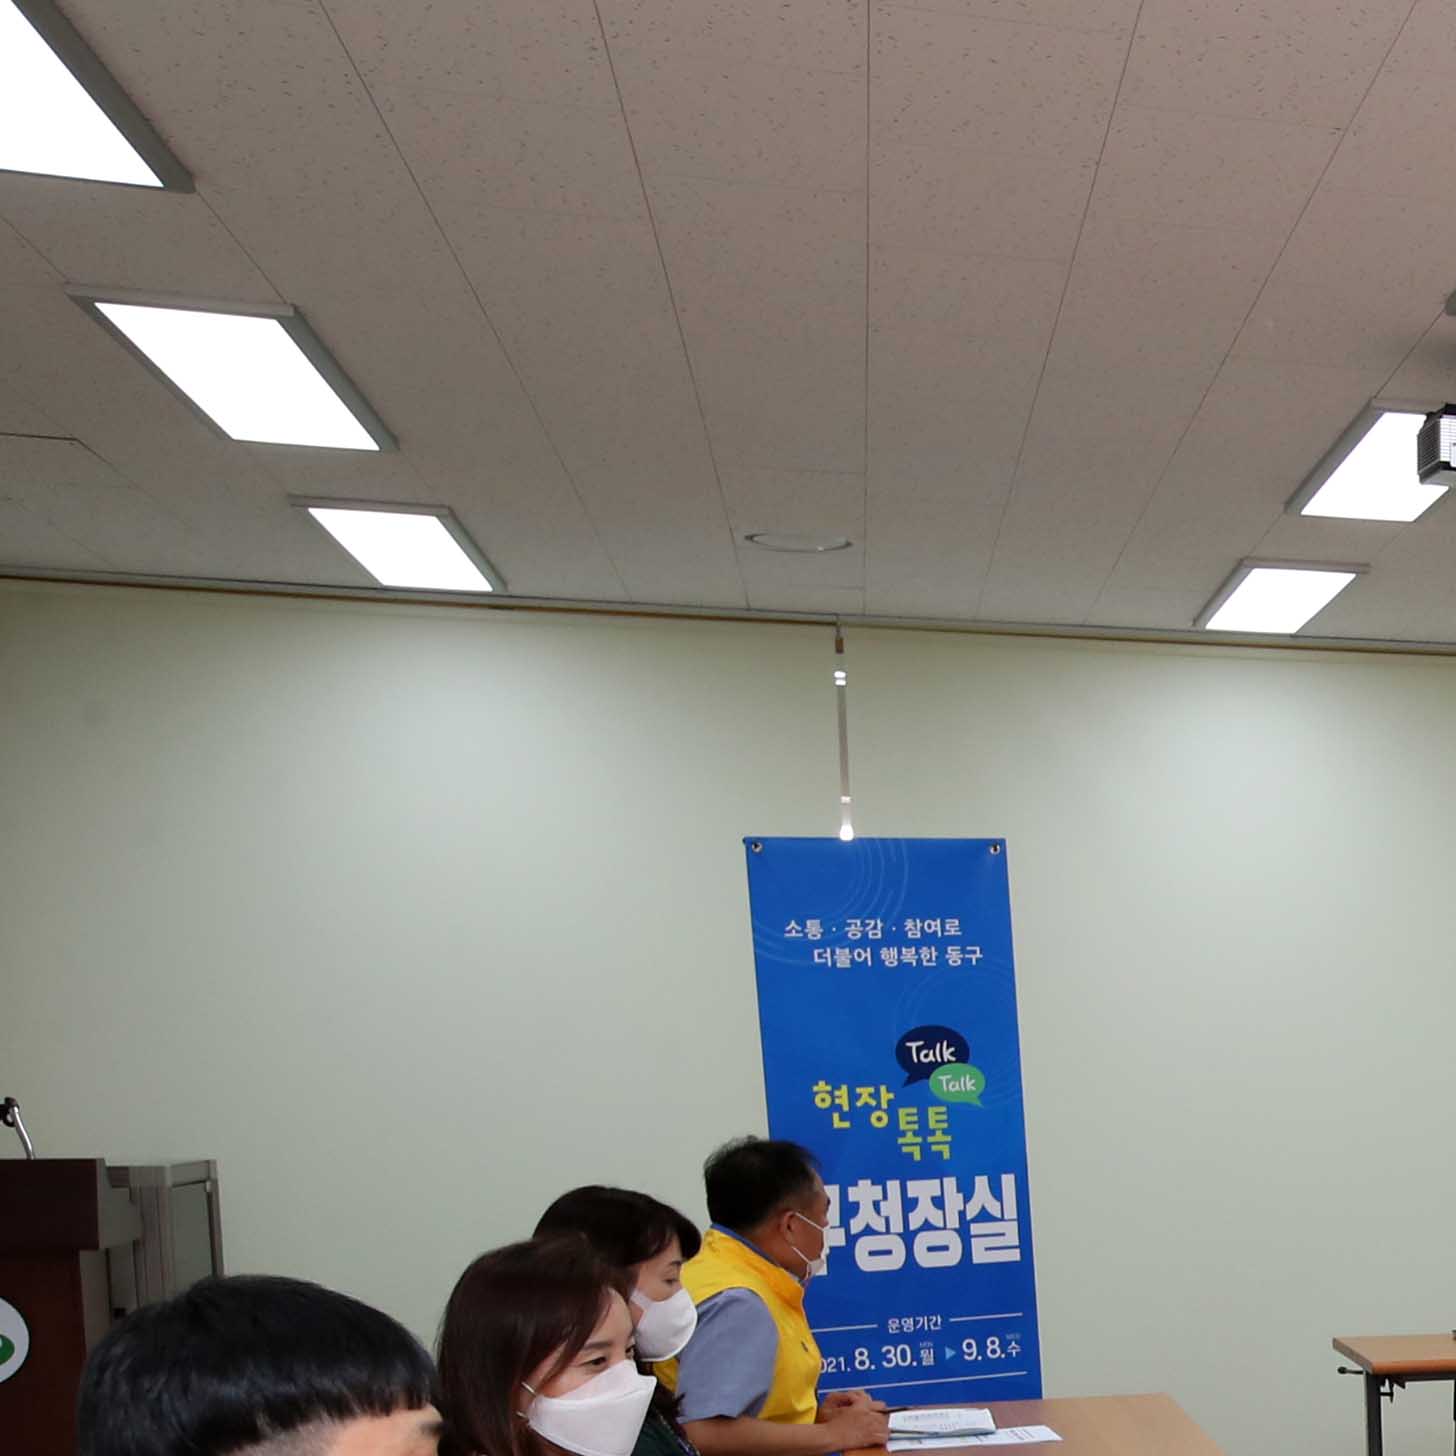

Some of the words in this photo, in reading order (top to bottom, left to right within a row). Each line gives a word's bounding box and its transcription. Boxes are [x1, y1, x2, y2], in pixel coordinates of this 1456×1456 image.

[783, 919, 824, 939] 소통
[844, 919, 883, 939] 공감
[904, 918, 962, 939] 참여로
[813, 947, 873, 968] 더불어
[880, 947, 938, 967] 행복한
[945, 946, 983, 966] 동구
[905, 1040, 956, 1063] Talk
[937, 1074, 976, 1092] Talk
[812, 1080, 895, 1129] 현장
[897, 1106, 953, 1161] 톡톡
[887, 1315, 942, 1334] 운영기간
